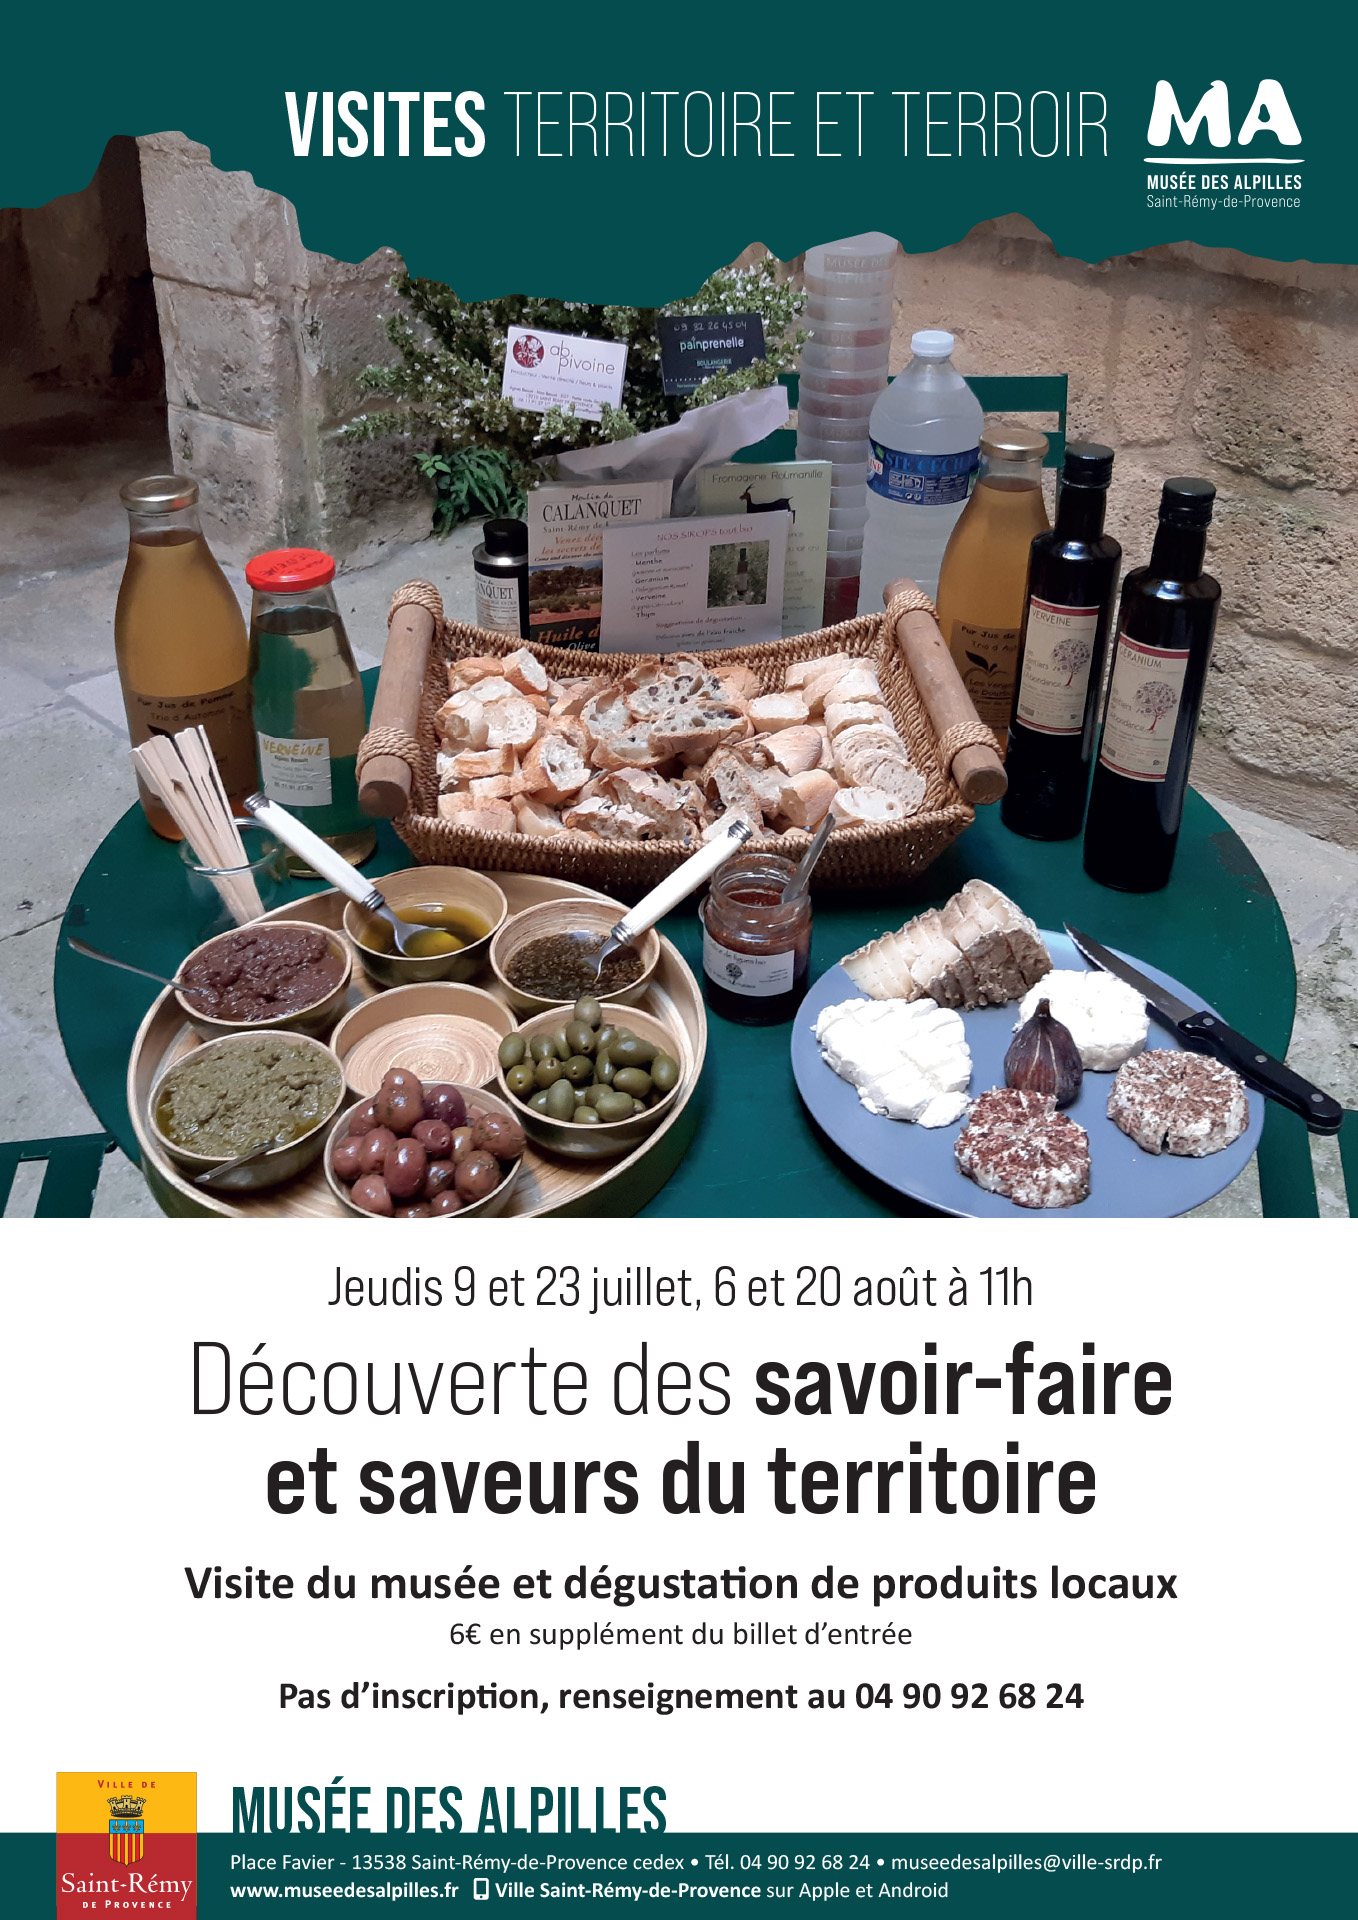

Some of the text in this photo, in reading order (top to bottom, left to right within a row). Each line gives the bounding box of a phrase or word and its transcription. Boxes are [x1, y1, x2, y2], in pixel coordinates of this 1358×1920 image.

[1147, 79, 1302, 147] MA
[285, 91, 1107, 157] VISITES TERRITOIRE ET TERROIR
[1147, 171, 1302, 190] MUSÉE DES ALPILLES
[1146, 195, 1300, 210] Saint-Rémy-de-Provence
[680, 336, 744, 353] painprenelle
[558, 355, 615, 375] pivoine
[542, 498, 642, 523] CALANQUET
[635, 557, 663, 566] Menthe
[635, 593, 666, 601] Verveine
[1031, 608, 1072, 627] VERVEINE
[537, 624, 584, 645] Huile
[980, 630, 999, 639] Jus
[157, 701, 177, 709] Jus
[181, 700, 196, 709] de
[328, 1265, 1032, 1315] Jeudis 9 et 23 juillet, 6 et 20 août à 11h
[194, 1341, 1172, 1416] Découverte des savoir-faire
[268, 1441, 1096, 1515] et saveurs du territoire
[185, 1565, 1177, 1606] Visite du musée et dégustation de produits locaux
[451, 1622, 912, 1651] 6€ en supplément du billet d’entrée
[281, 1682, 1084, 1716] Pas d’inscription, renseignement au 04 90 92 68 24
[233, 1776, 667, 1834] MUSÉE DES ALPILLES
[231, 1854, 276, 1870] Place
[283, 1854, 334, 1870] Favier
[352, 1854, 407, 1870] 13538
[411, 1853, 627, 1873] Saint-Rémy-de-Provence
[634, 1854, 685, 1870] cedex
[705, 1854, 734, 1870] Tél.
[741, 1854, 762, 1870] 04
[768, 1854, 789, 1870] 90
[795, 1854, 816, 1870] 92
[822, 1854, 844, 1870] 68
[849, 1854, 870, 1870] 24
[892, 1853, 1163, 1874] museedesalpilles@ville-srdp.fr
[61, 1872, 193, 1899] Saint-Rémy
[230, 1881, 948, 1902] www.museedesalpilles.fr Ville Saint-Rémy-de-Provence sur Apple et Android
